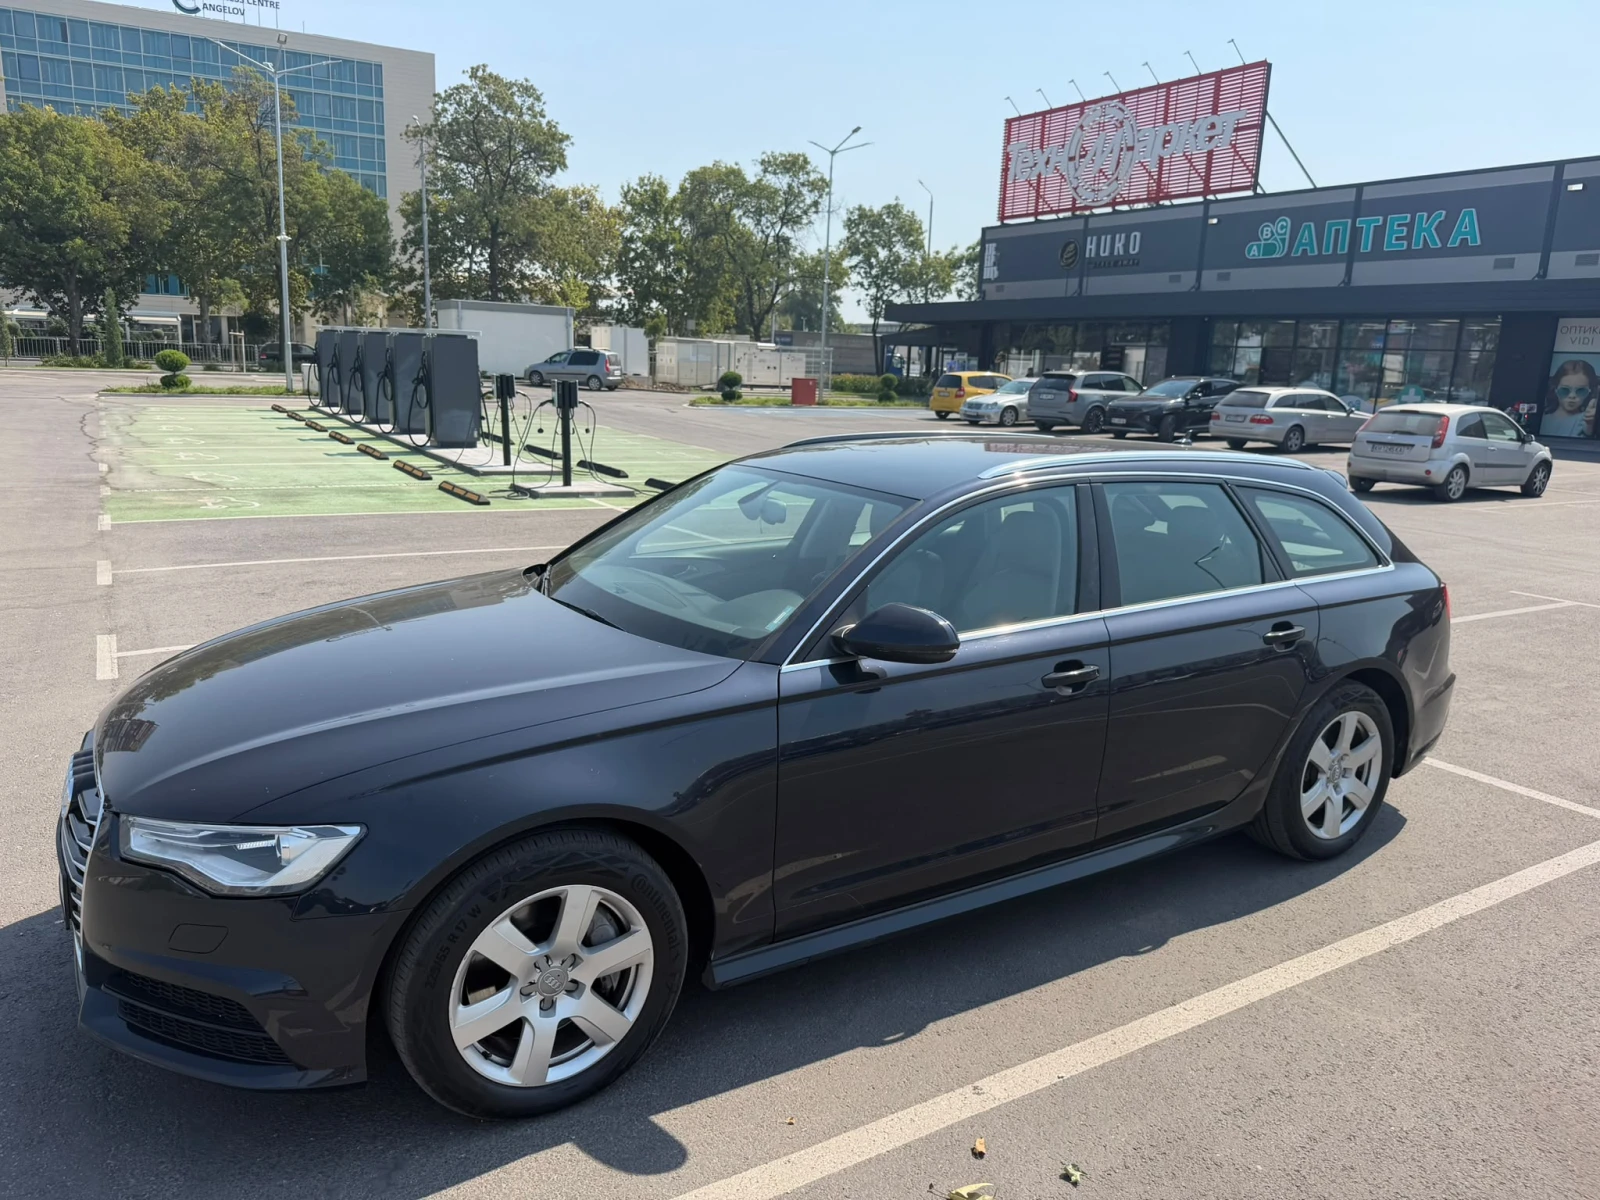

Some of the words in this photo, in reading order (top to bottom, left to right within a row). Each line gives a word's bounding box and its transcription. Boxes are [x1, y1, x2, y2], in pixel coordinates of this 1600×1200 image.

[202, 3, 245, 16] ANGELOV
[247, 0, 280, 9] CENTRE
[1291, 208, 1482, 256] АПТЕКА
[1560, 325, 1600, 335] ОПТИК
[1570, 336, 1594, 346] VIDI
